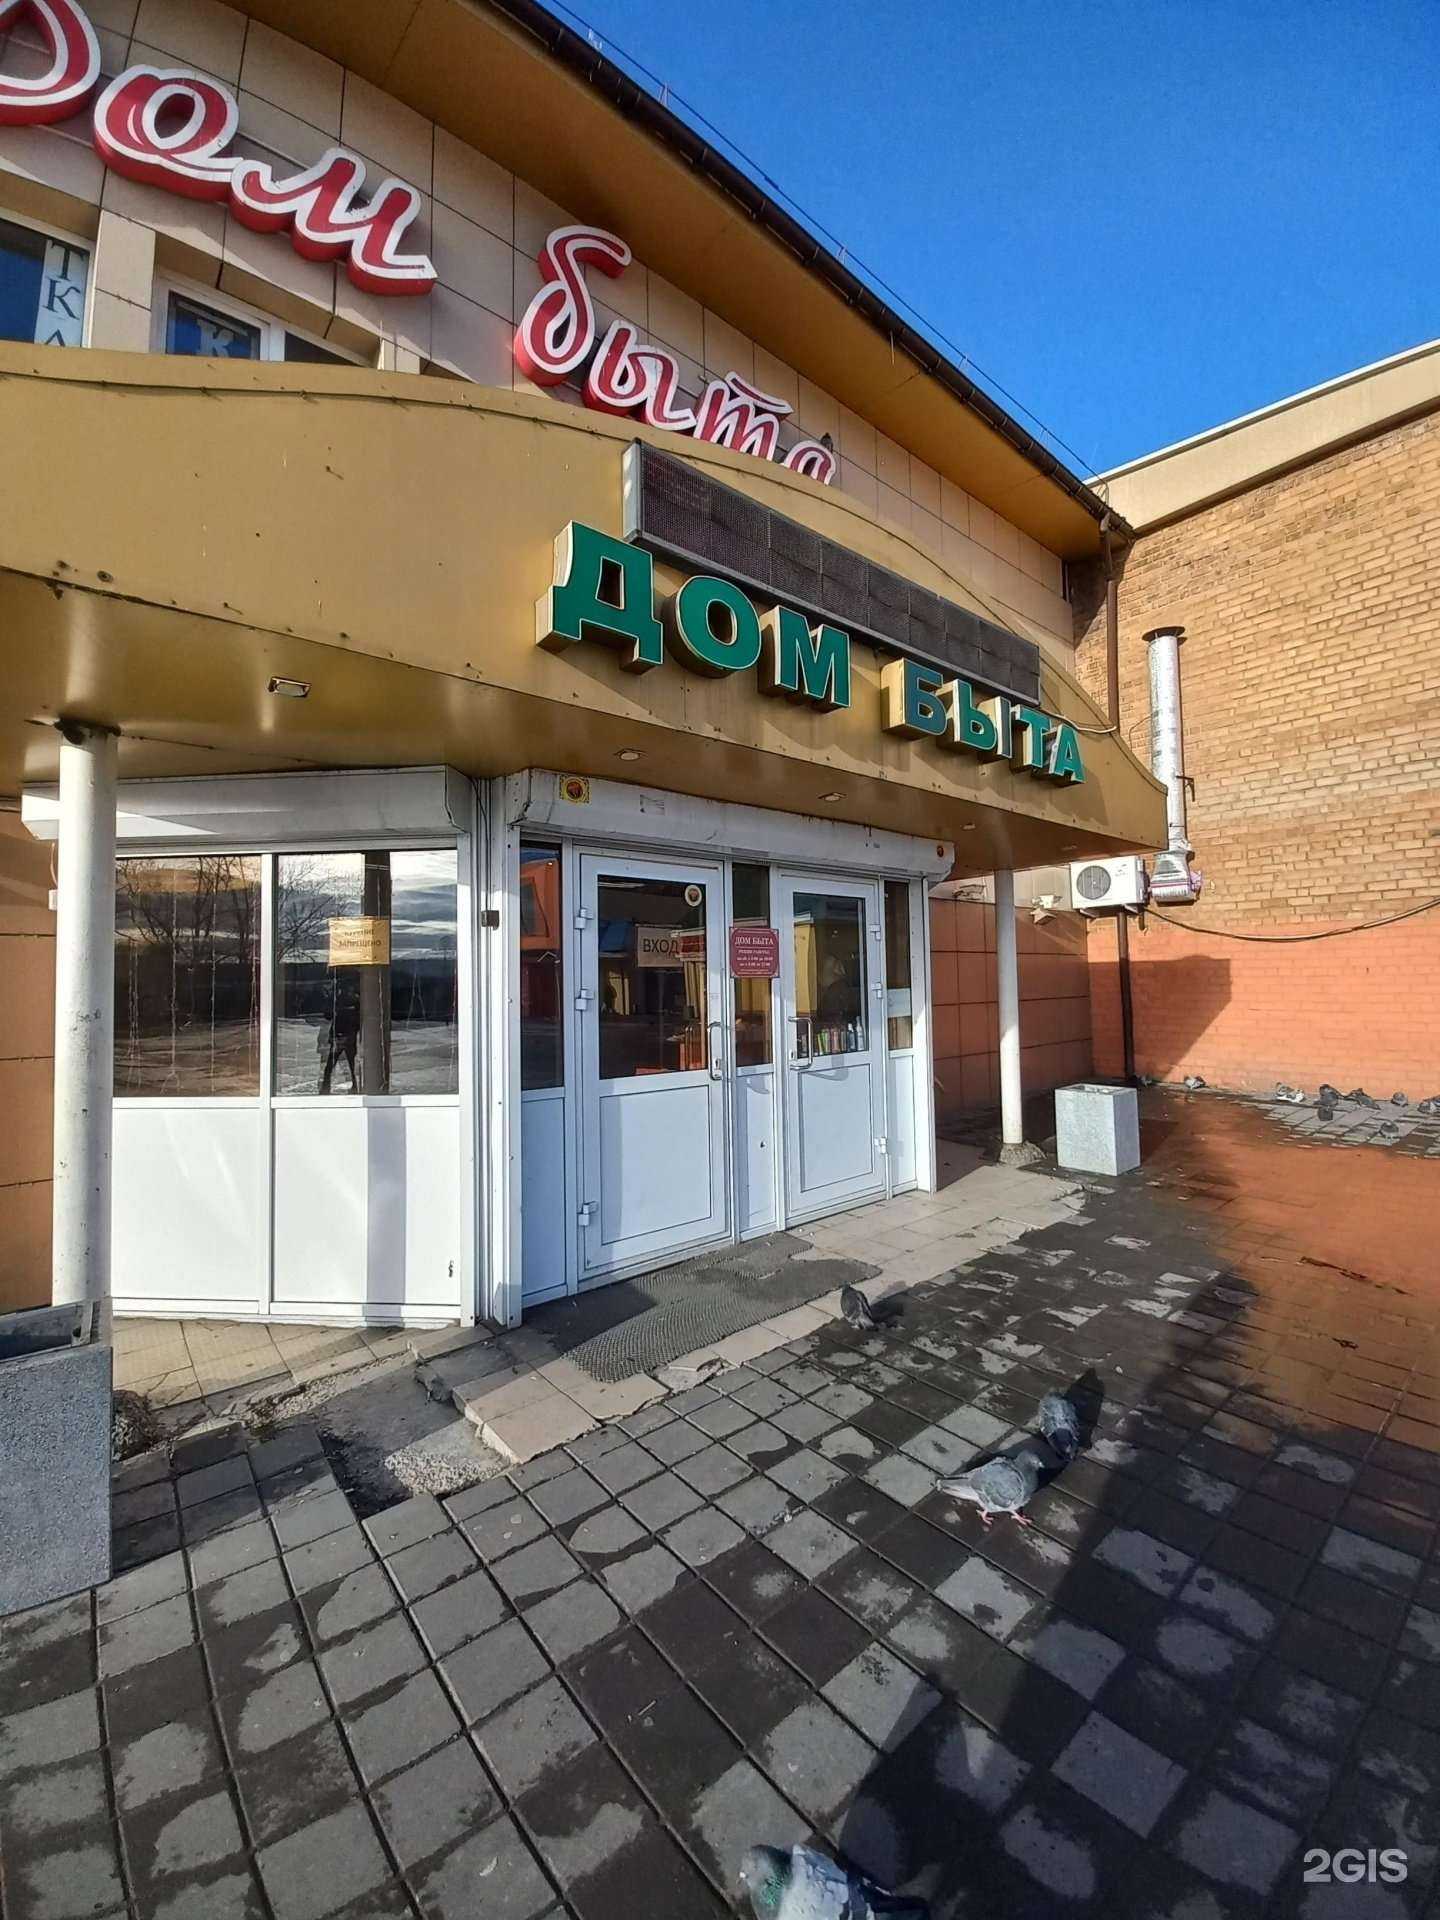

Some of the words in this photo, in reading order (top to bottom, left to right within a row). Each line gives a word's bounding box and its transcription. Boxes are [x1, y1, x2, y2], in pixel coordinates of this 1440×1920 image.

[546, 520, 851, 710] ДОМ
[896, 657, 1086, 785] БЫТА
[643, 938, 680, 957] ВХОД
[735, 936, 751, 945] ДОМ
[752, 936, 774, 945] БЫТА
